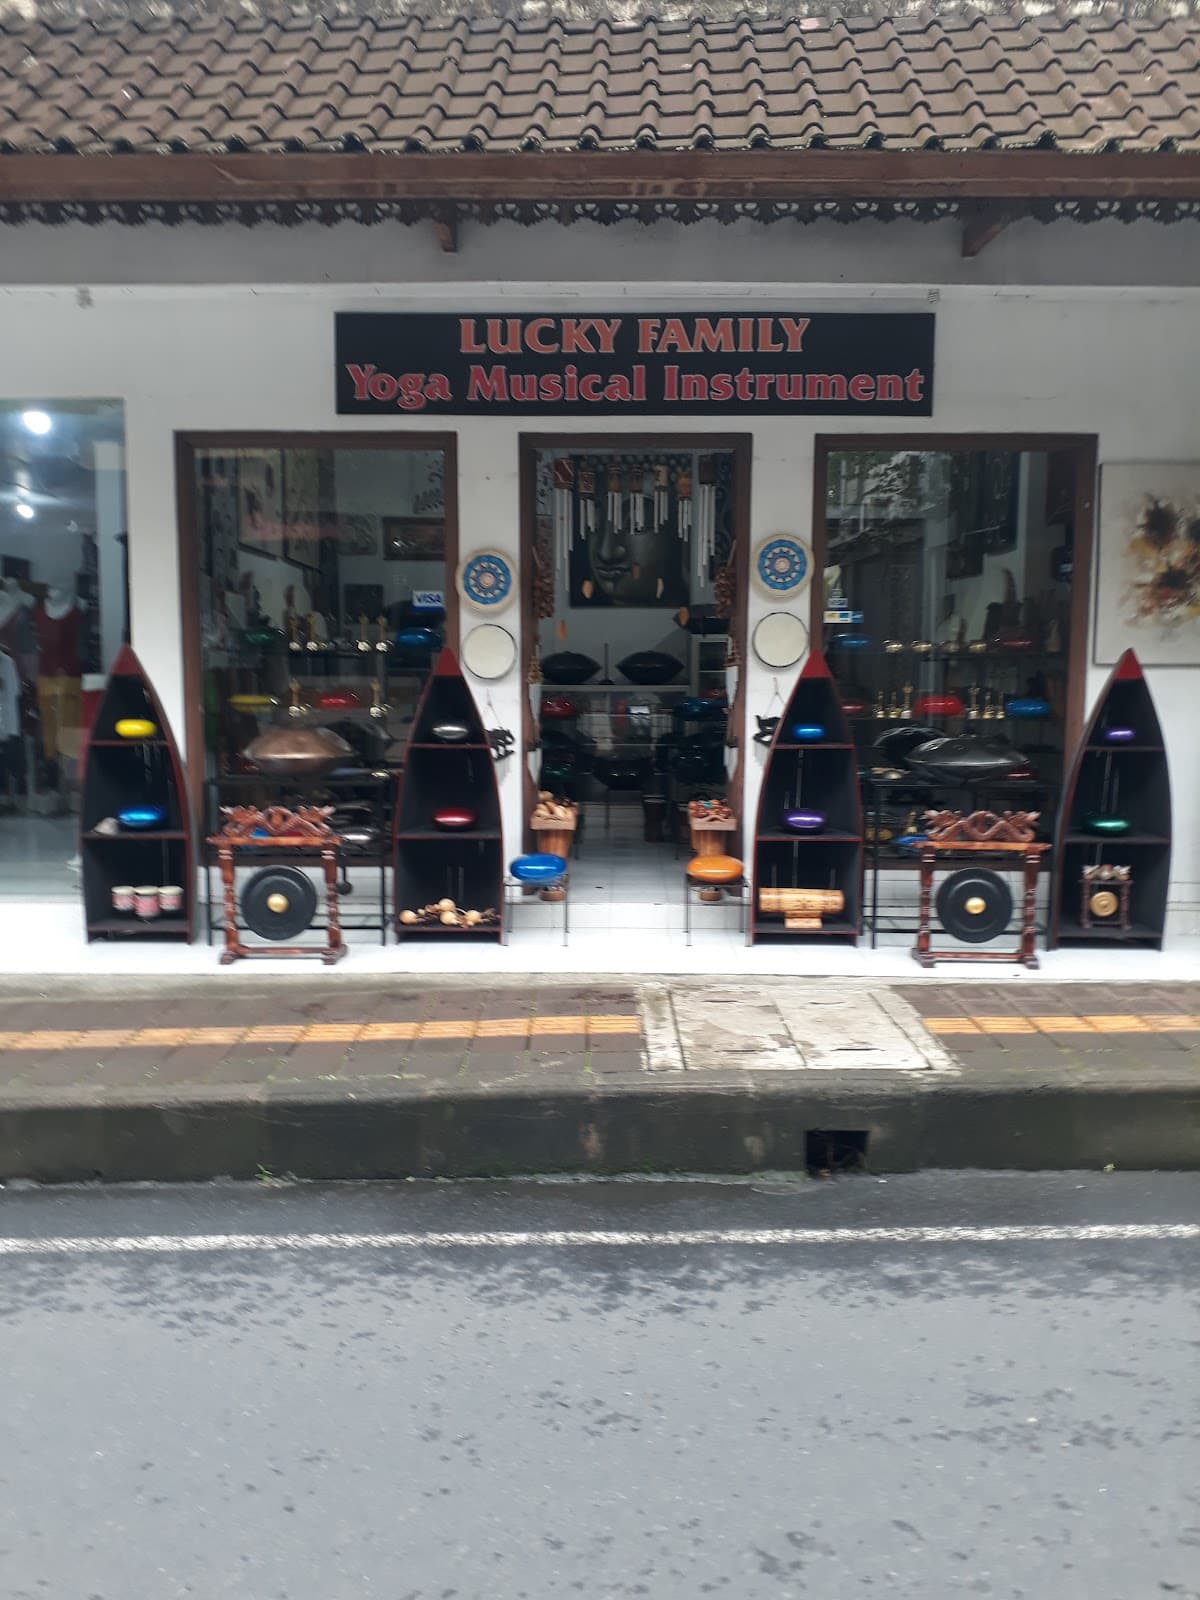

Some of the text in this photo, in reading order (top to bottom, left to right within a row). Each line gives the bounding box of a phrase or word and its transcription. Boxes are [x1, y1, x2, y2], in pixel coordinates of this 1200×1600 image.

[459, 317, 811, 353] LUCKY FAMILY
[345, 363, 925, 410] Yoga Musical Instrument
[415, 593, 441, 604] VISA
